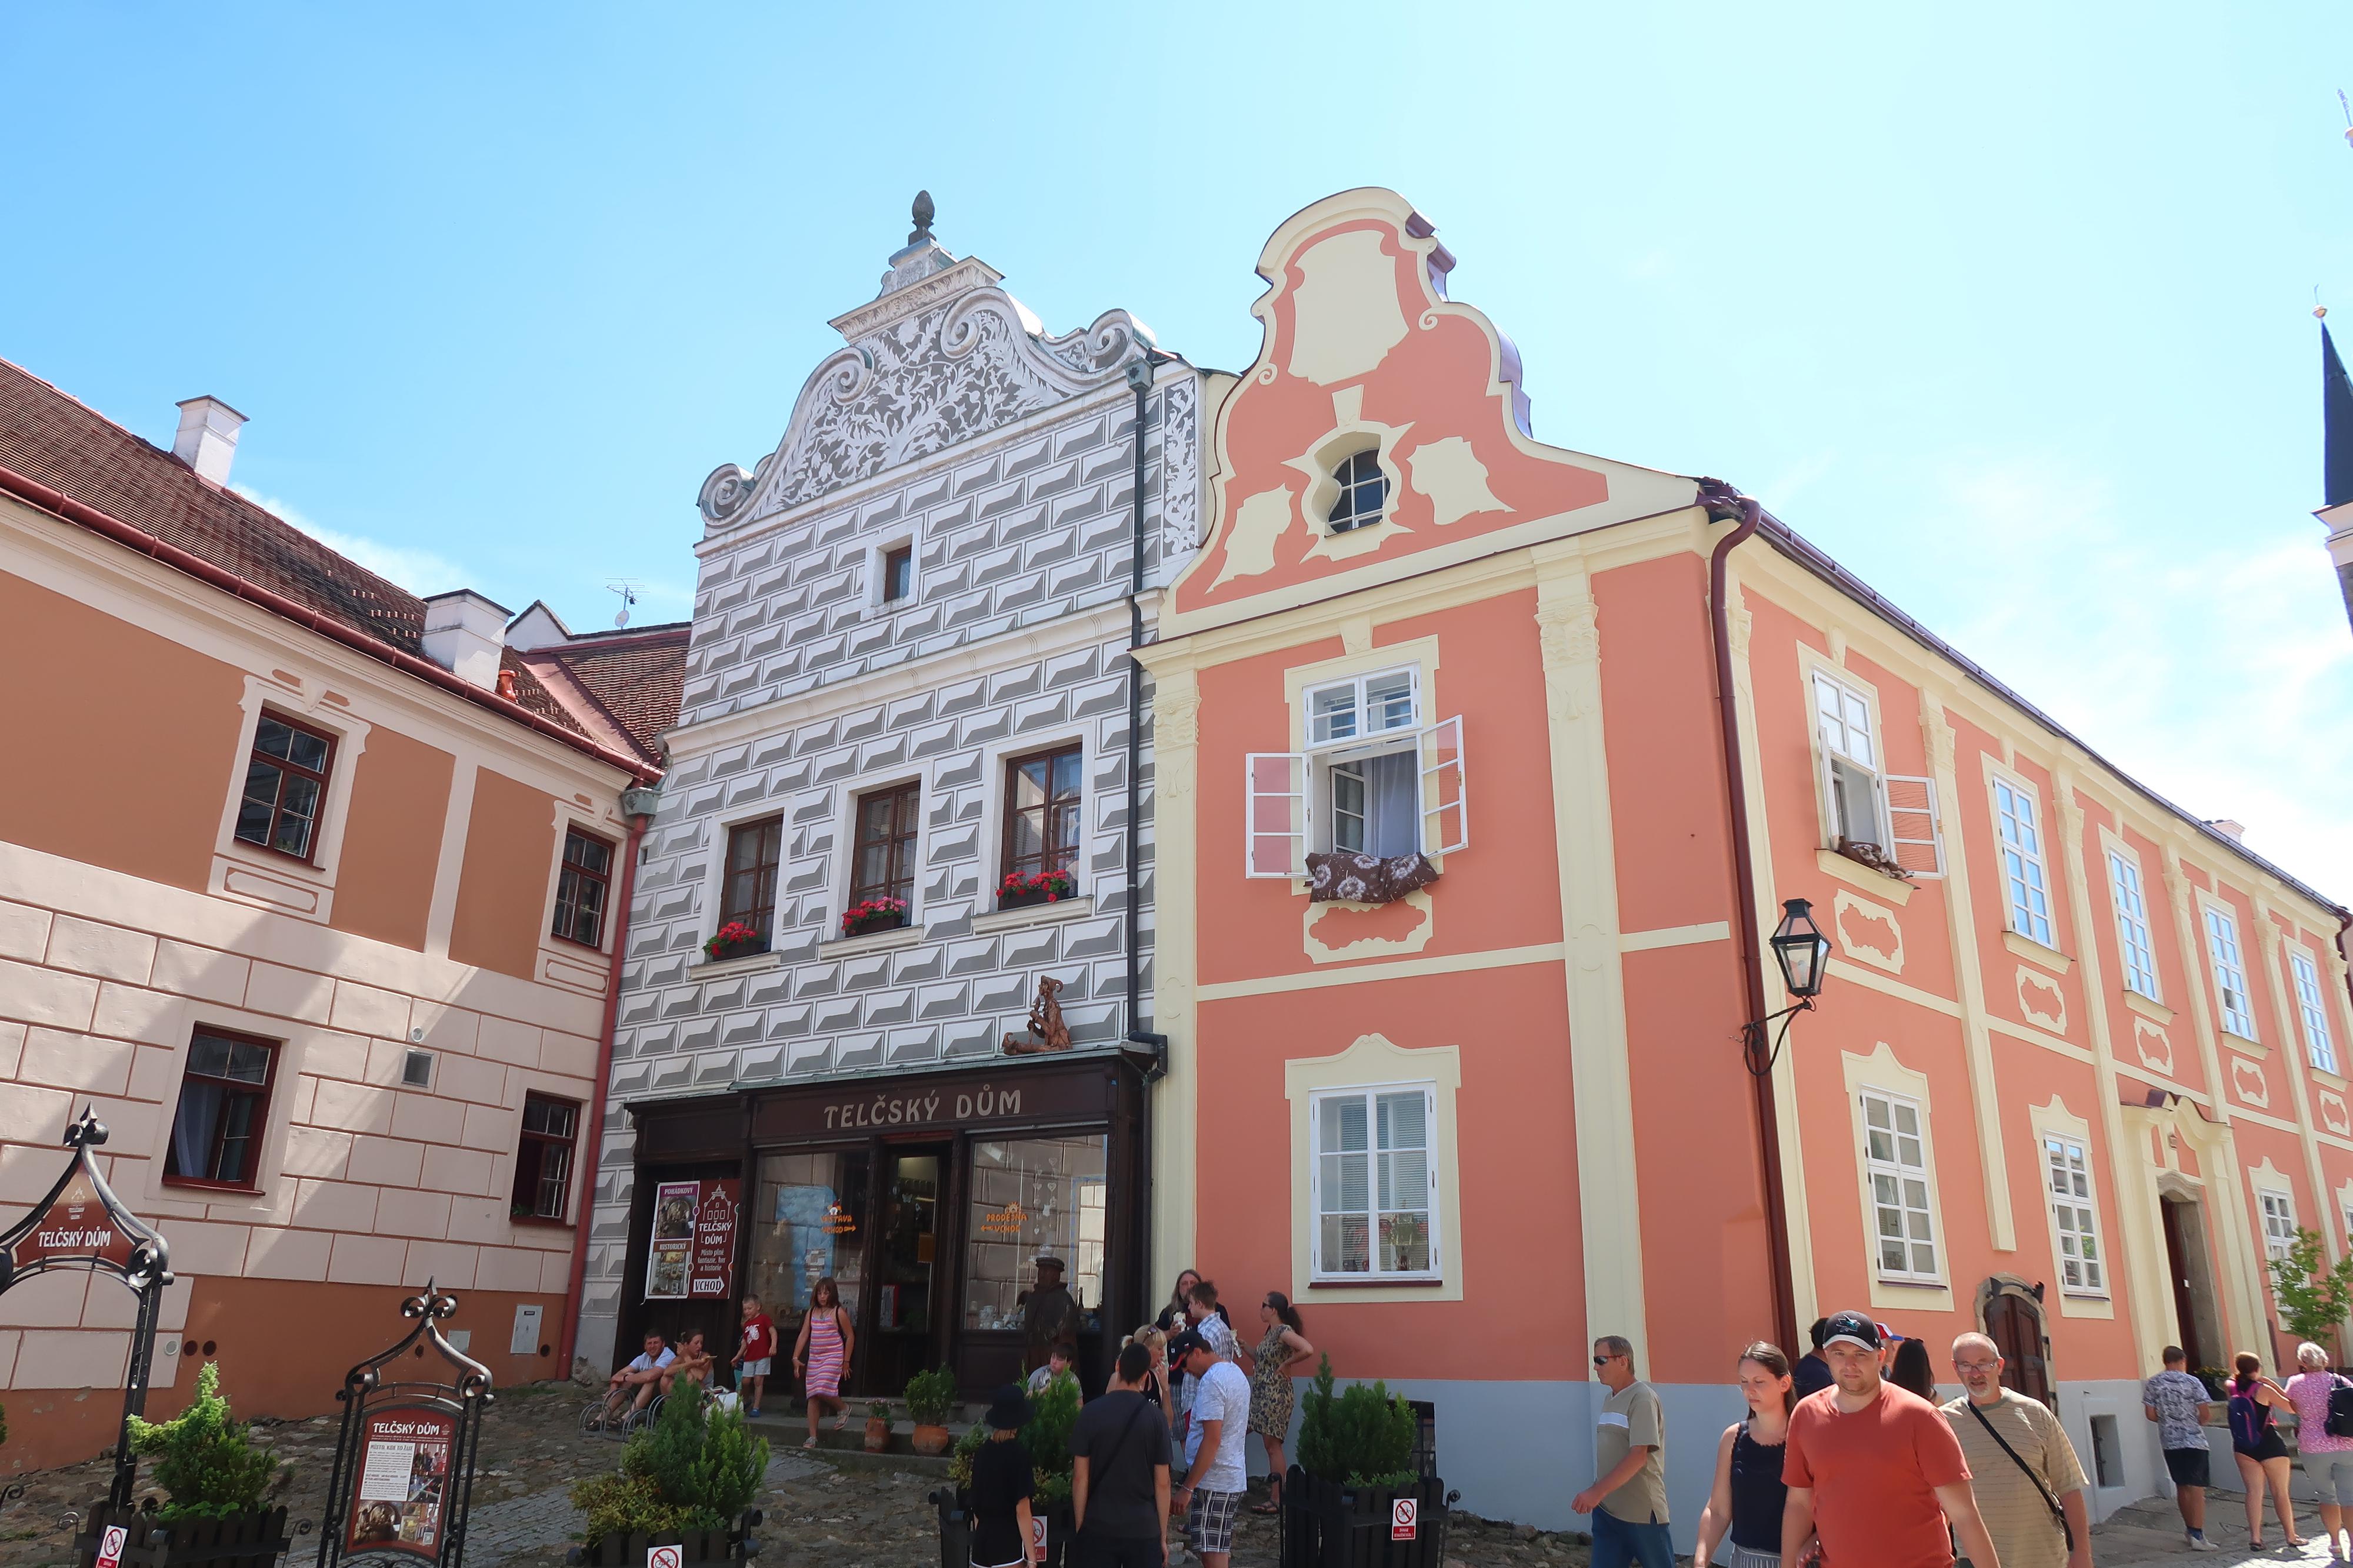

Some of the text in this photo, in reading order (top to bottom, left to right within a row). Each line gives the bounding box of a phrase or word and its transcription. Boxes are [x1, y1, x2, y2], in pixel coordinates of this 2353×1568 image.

[824, 1084, 1021, 1129] TELČSKÝ DŮM
[665, 1186, 694, 1195] POHÁDKOVÝ
[699, 1220, 732, 1232] TELČSKÝ
[38, 1226, 111, 1247] TELČSKÝ DŮM
[659, 1242, 687, 1250] HISTORICKÝ
[713, 1248, 724, 1257] plné
[695, 1280, 721, 1291] VCHOD
[373, 1420, 440, 1435] TELČSKÝ DŮM
